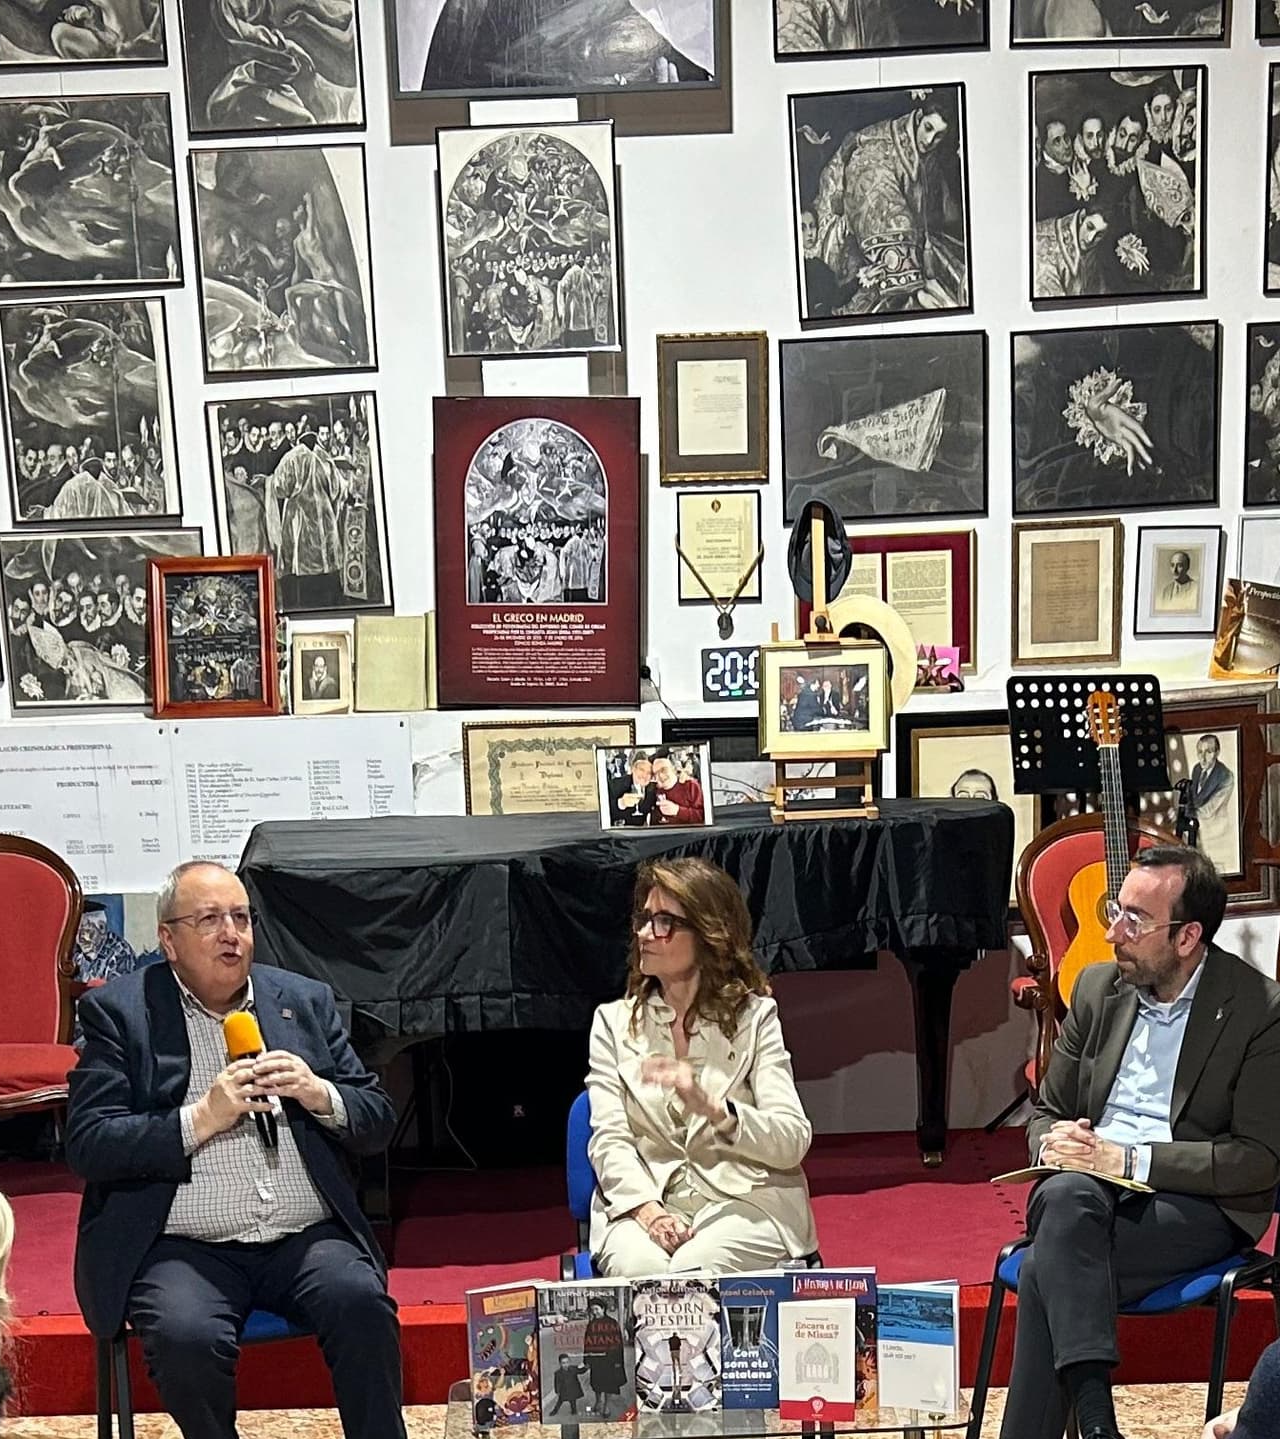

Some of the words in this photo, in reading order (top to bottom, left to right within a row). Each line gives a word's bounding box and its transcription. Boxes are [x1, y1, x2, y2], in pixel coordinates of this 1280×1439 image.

[493, 613, 502, 623] EL
[503, 613, 534, 623] GRECO
[536, 613, 548, 623] EN
[549, 613, 585, 623] MADRID
[312, 640, 343, 648] GRECO
[644, 1303, 704, 1314] RETORN
[795, 1322, 824, 1330] Encara
[795, 1330, 805, 1338] de
[807, 1331, 839, 1339] Missa?
[733, 1349, 760, 1358] Com
[724, 1361, 749, 1369] som
[751, 1359, 769, 1369] els
[721, 1370, 772, 1379] catalans
